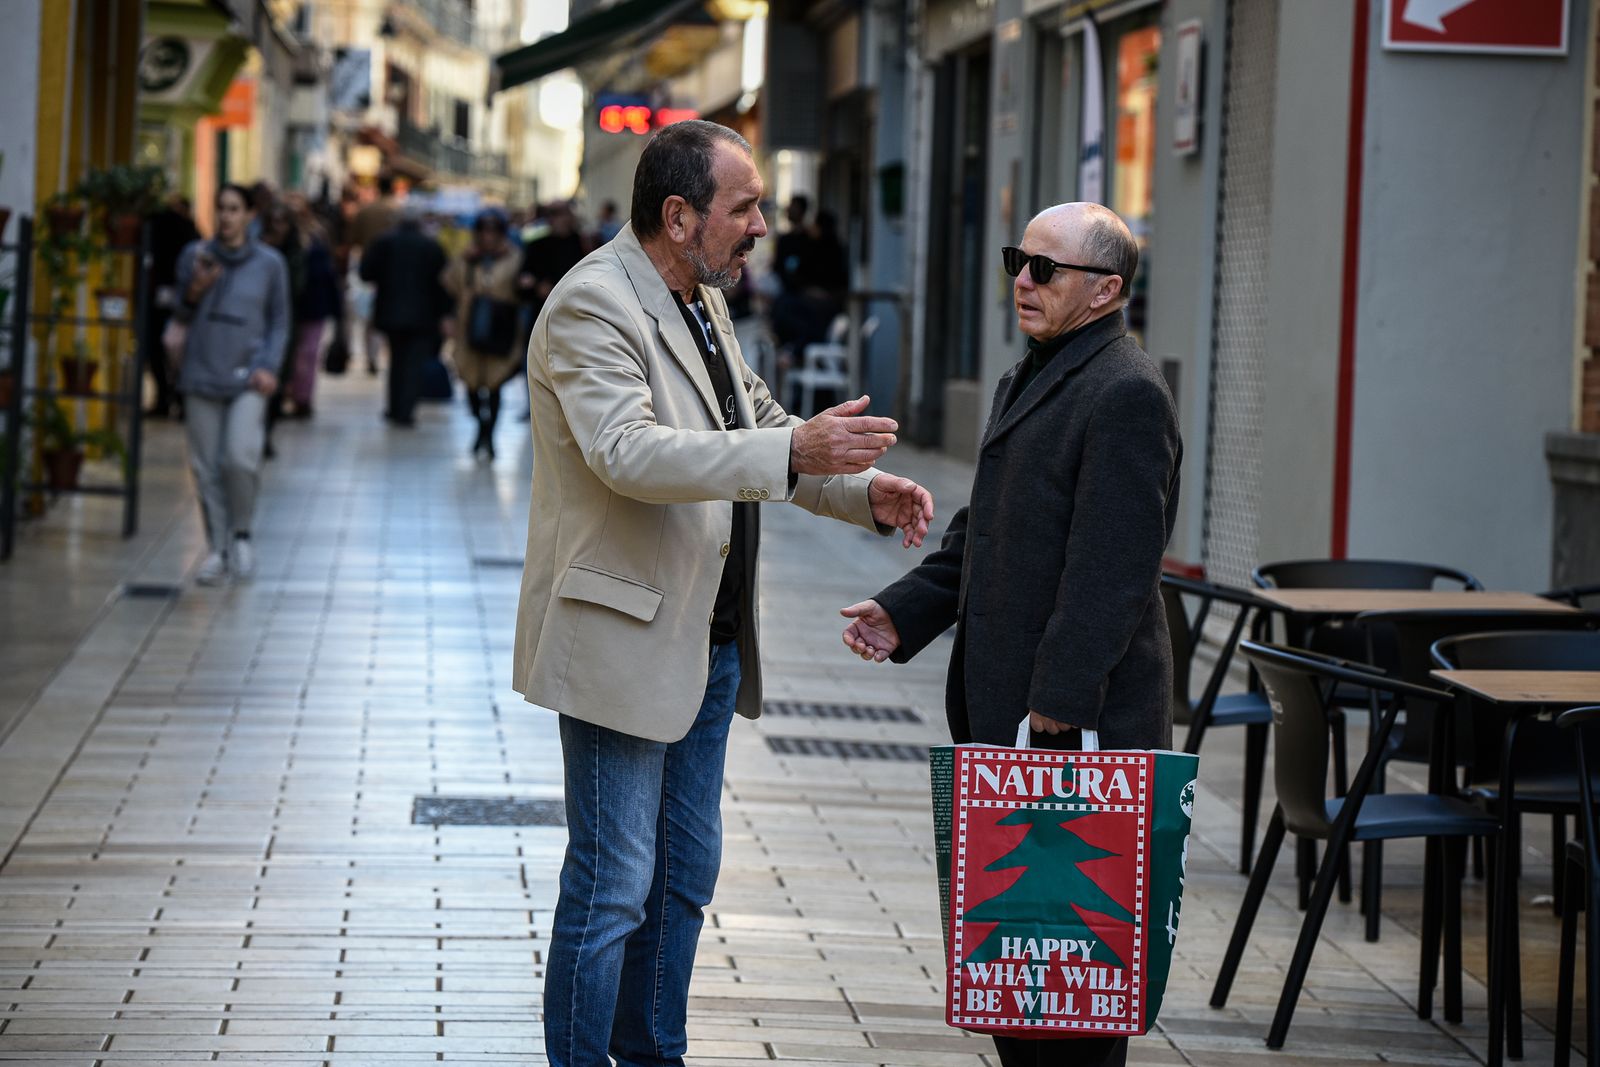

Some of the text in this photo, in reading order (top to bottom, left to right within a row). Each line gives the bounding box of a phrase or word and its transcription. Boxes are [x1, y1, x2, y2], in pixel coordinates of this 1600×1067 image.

[974, 764, 1133, 803] NATURA
[1001, 937, 1096, 962] HAPPY
[967, 963, 1127, 990] WHAT WILL
[966, 989, 1125, 1017] BE WILL BE
